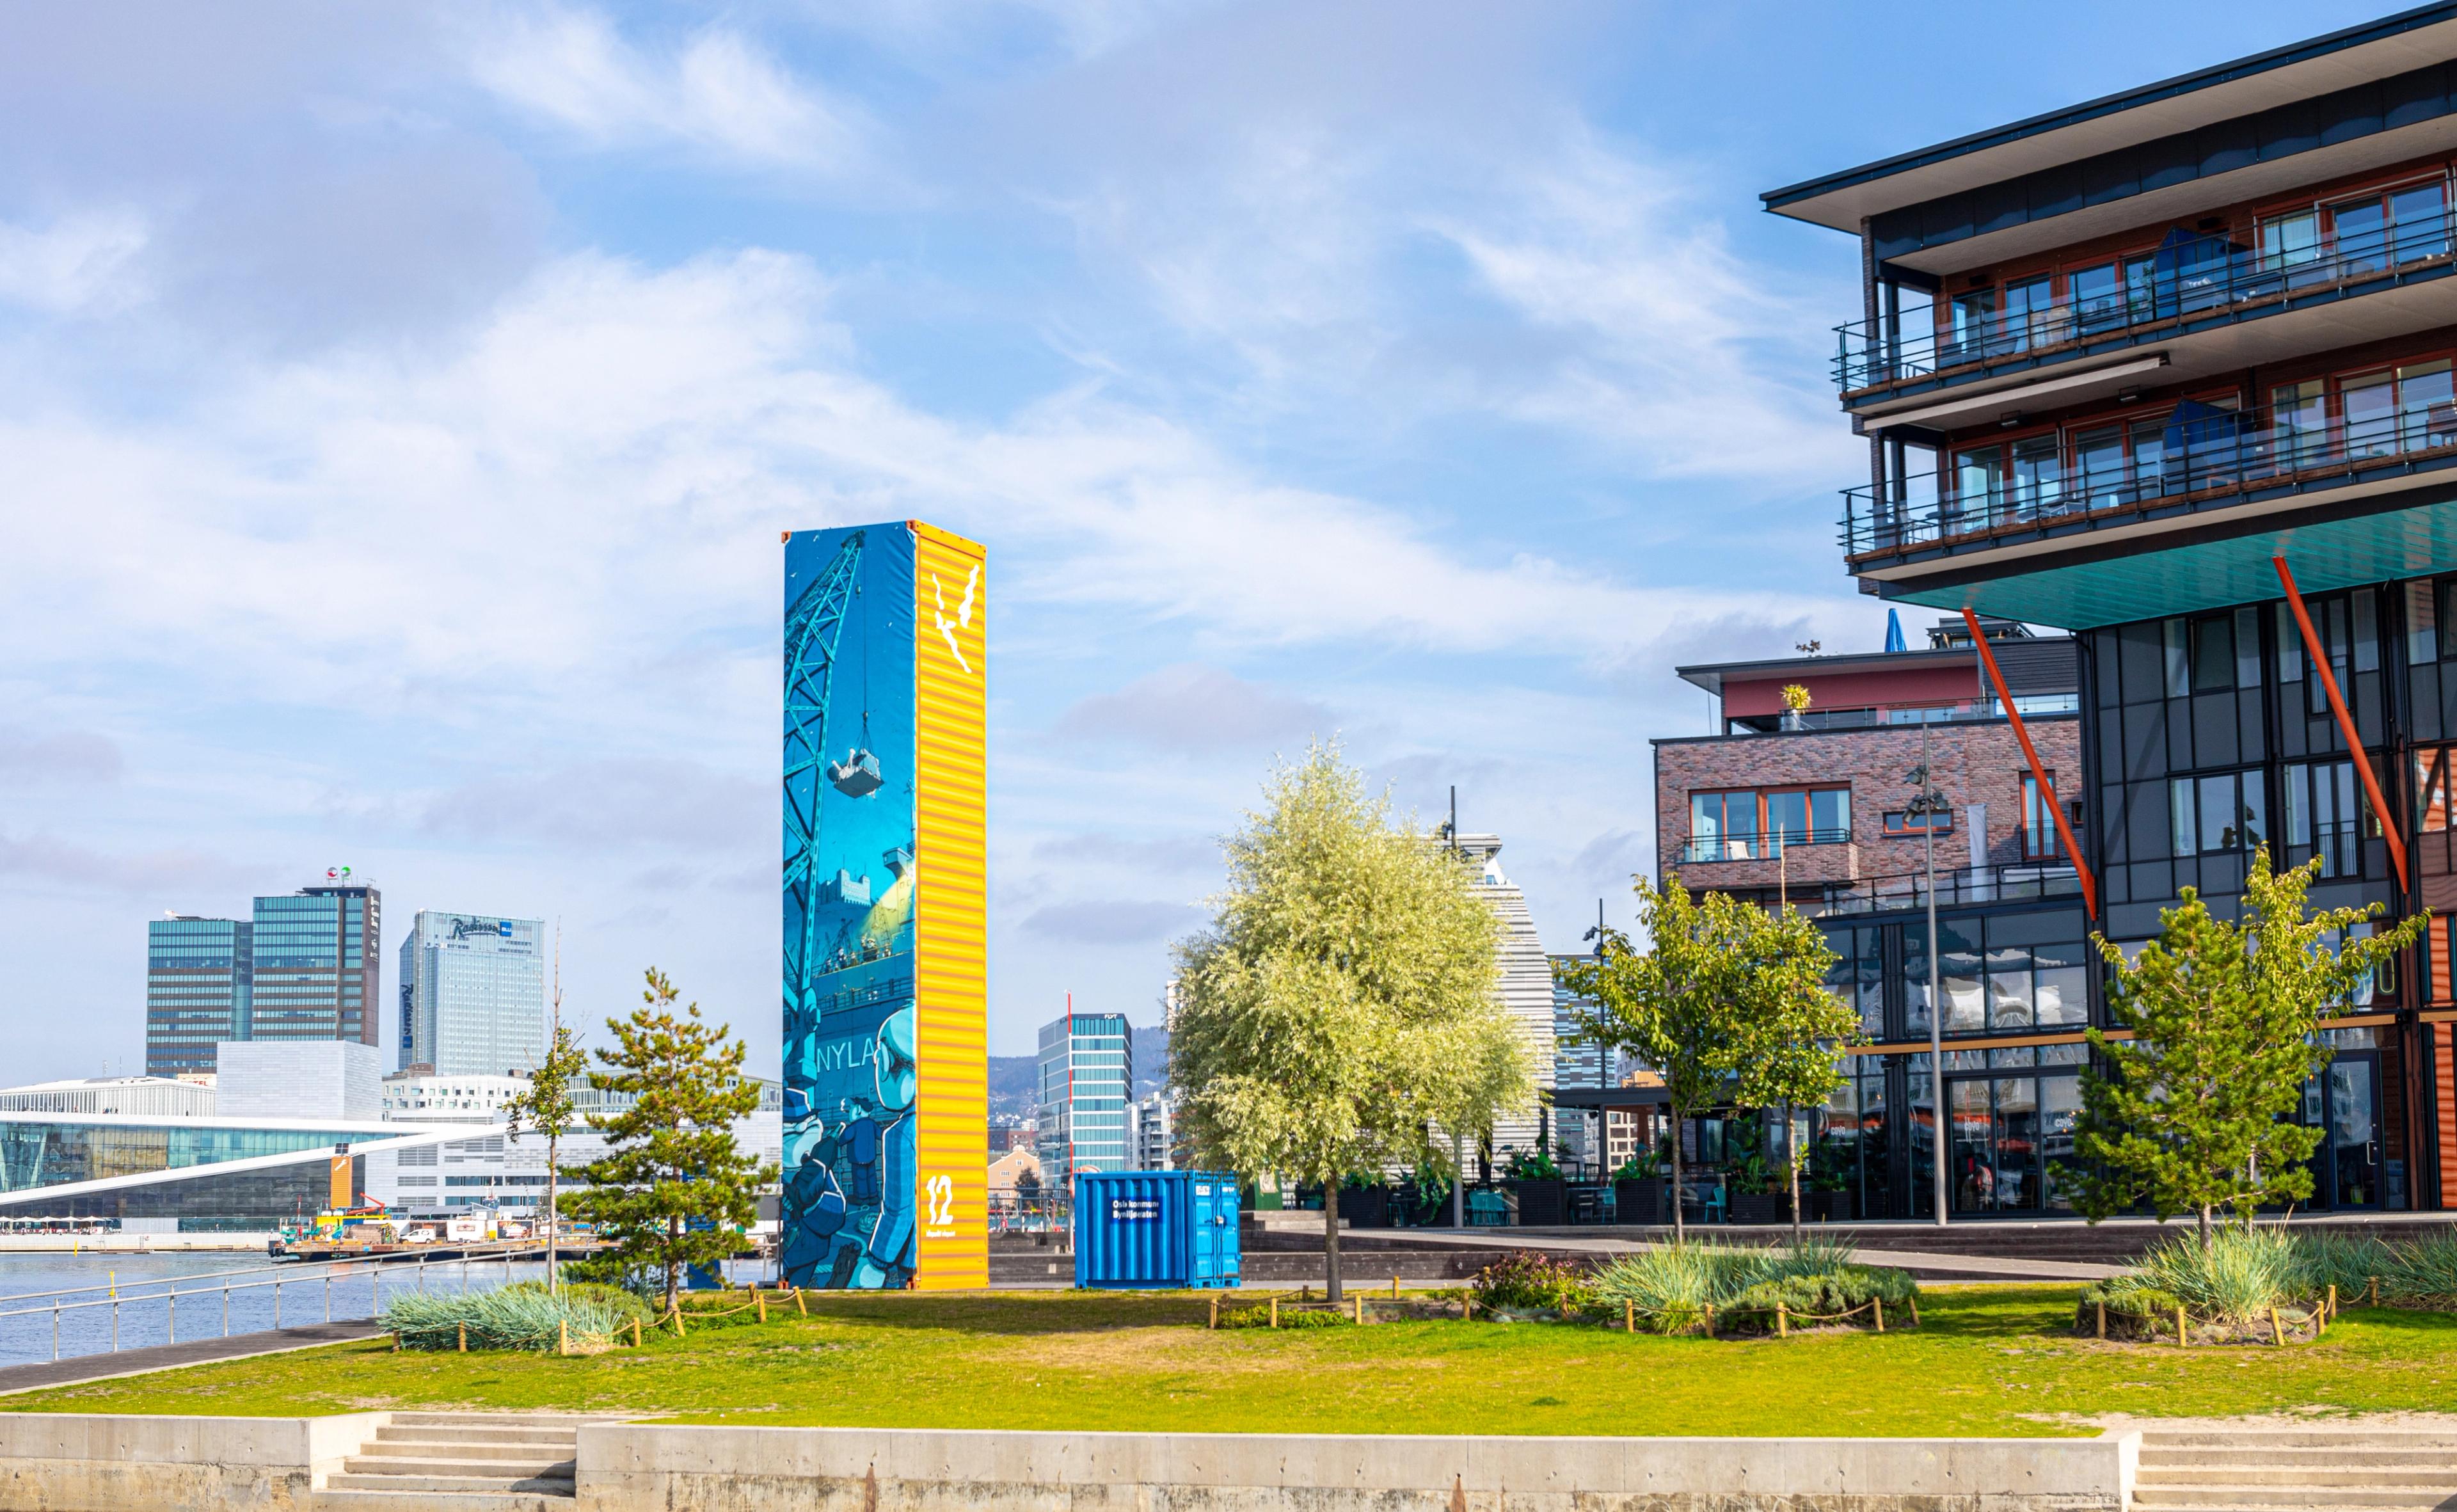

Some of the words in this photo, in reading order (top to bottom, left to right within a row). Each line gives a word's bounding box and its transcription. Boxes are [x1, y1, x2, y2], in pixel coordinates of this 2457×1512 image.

[452, 916, 499, 939] Radisson
[1831, 1126, 1845, 1136] COYO
[926, 1175, 953, 1225] 12
